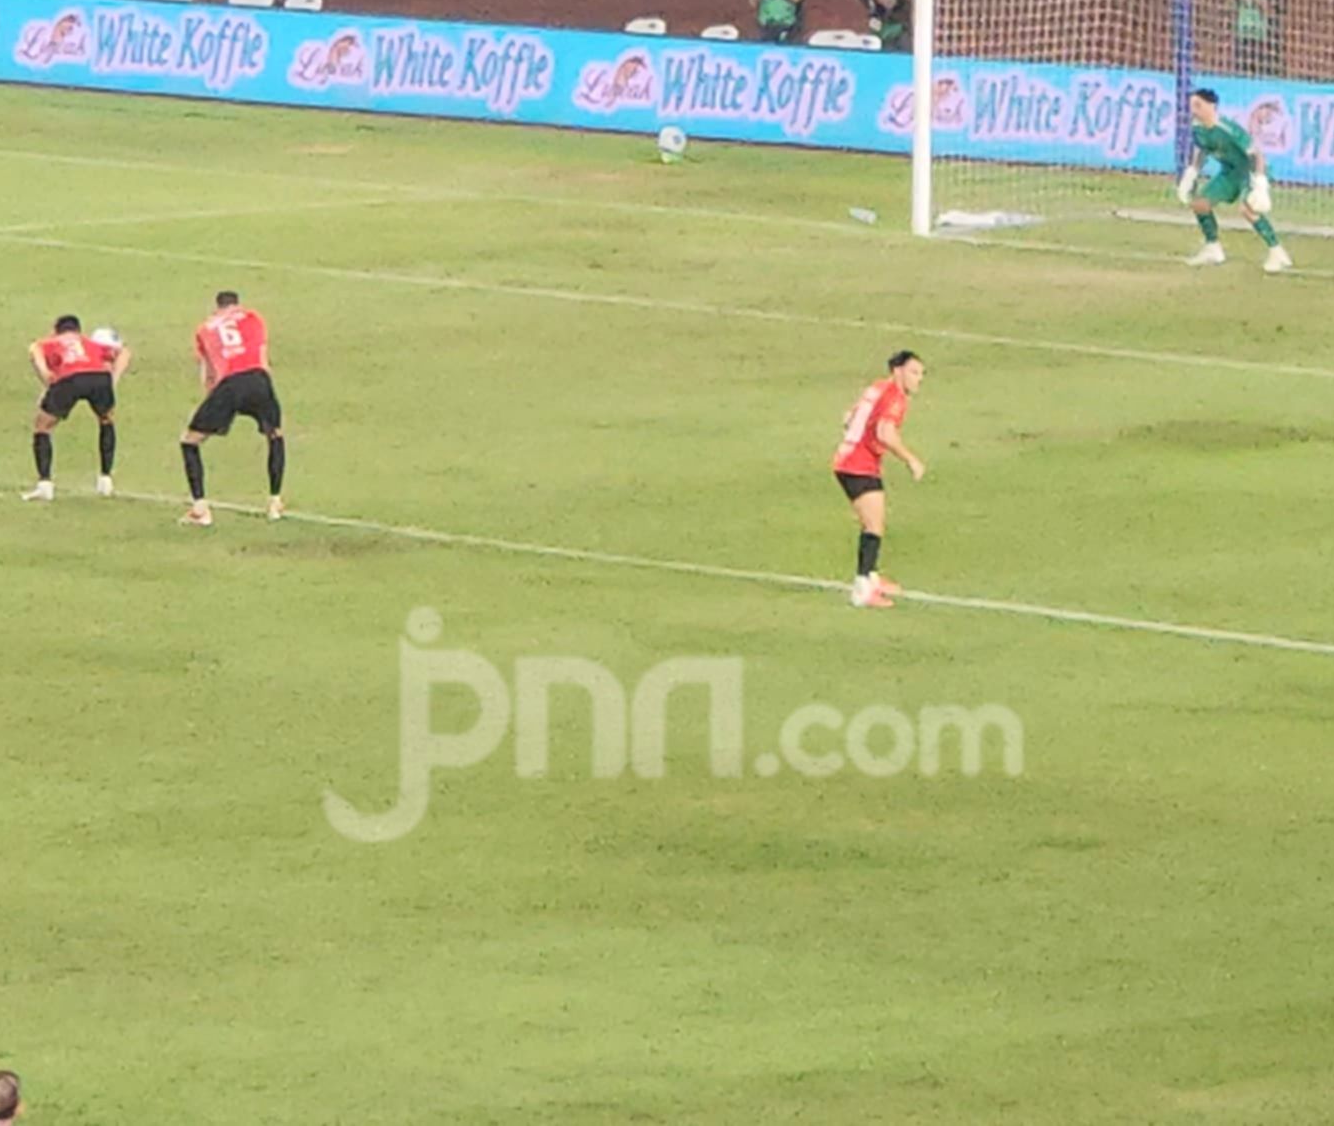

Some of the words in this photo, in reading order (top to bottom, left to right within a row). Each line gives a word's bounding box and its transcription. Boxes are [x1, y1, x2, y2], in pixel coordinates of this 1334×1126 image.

[94, 12, 169, 68] White
[176, 17, 263, 84] Koffie
[373, 32, 454, 89] White
[458, 37, 549, 107] Koffie
[661, 53, 749, 112] White
[753, 58, 849, 129] Koffie
[973, 75, 1061, 135] White
[1069, 80, 1172, 154] Koffie
[218, 319, 243, 347] 6
